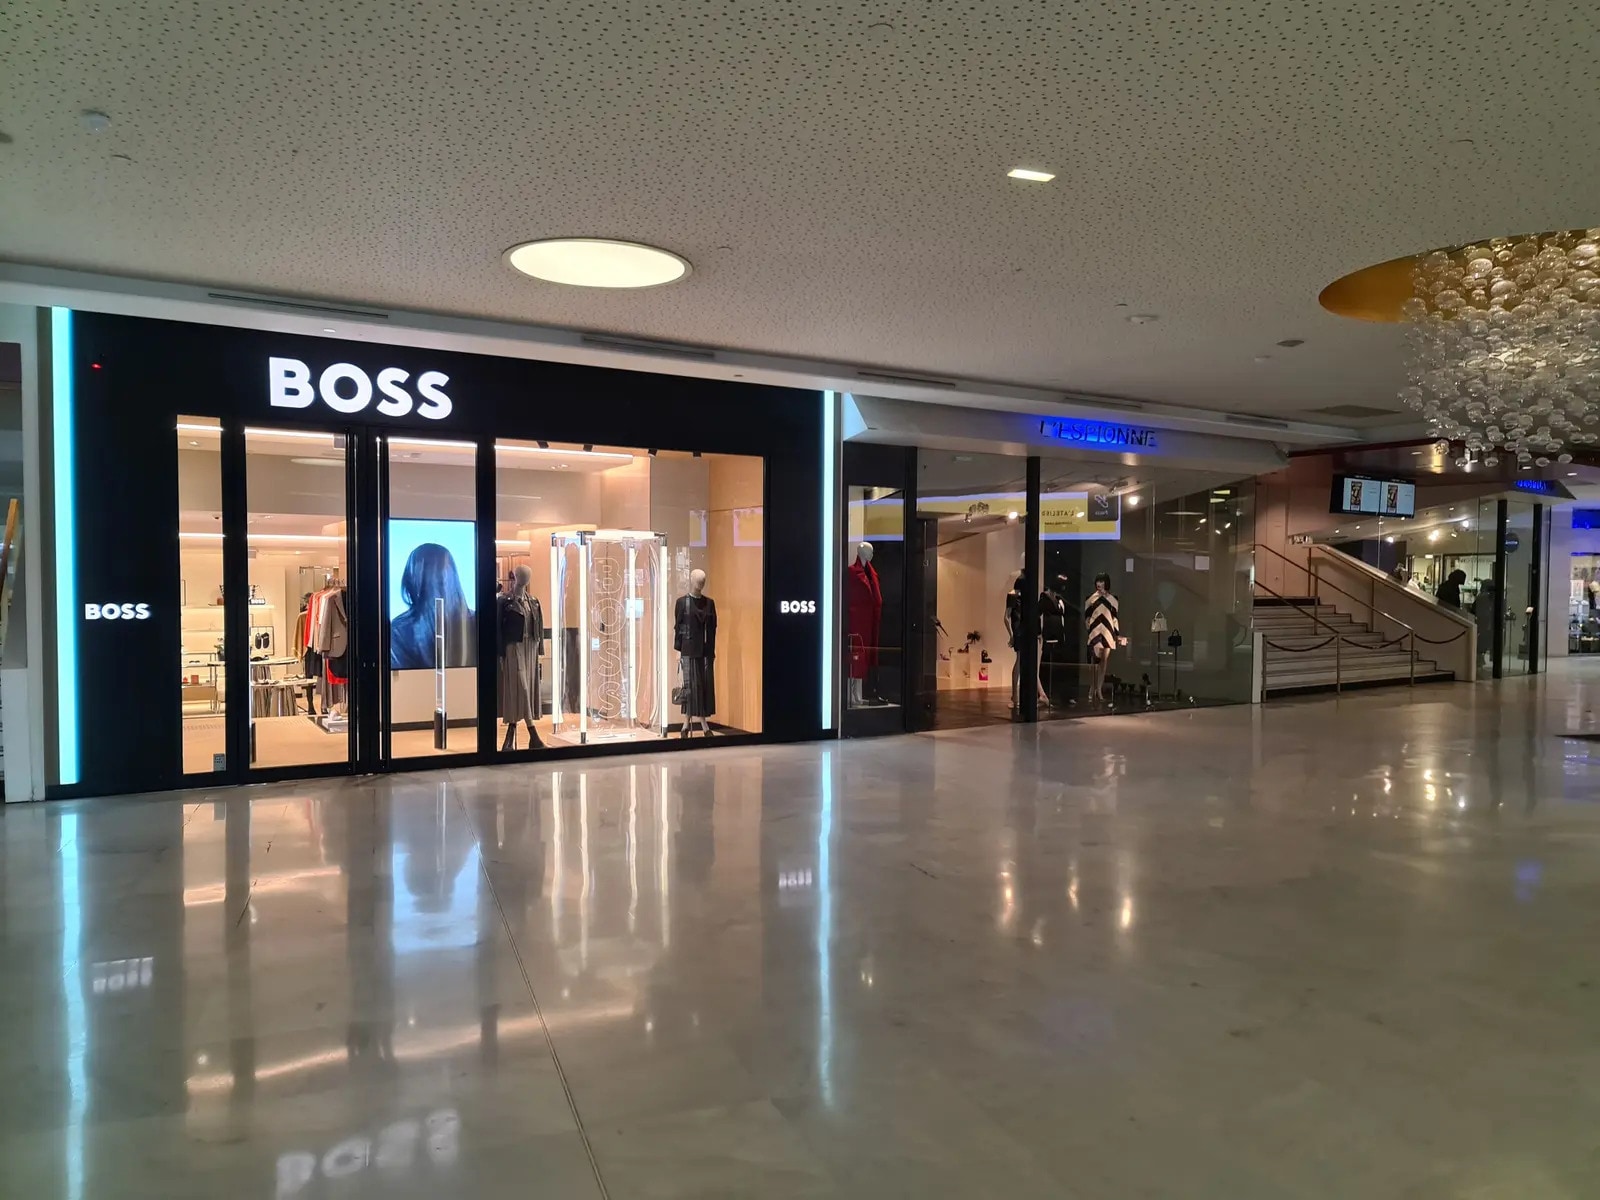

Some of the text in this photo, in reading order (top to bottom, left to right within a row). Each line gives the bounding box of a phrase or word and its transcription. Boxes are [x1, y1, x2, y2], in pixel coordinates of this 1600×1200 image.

[269, 356, 453, 420] BOSS
[1039, 420, 1158, 448] L'ESPIONNE
[84, 603, 152, 620] BOSS
[780, 600, 816, 614] BOSS
